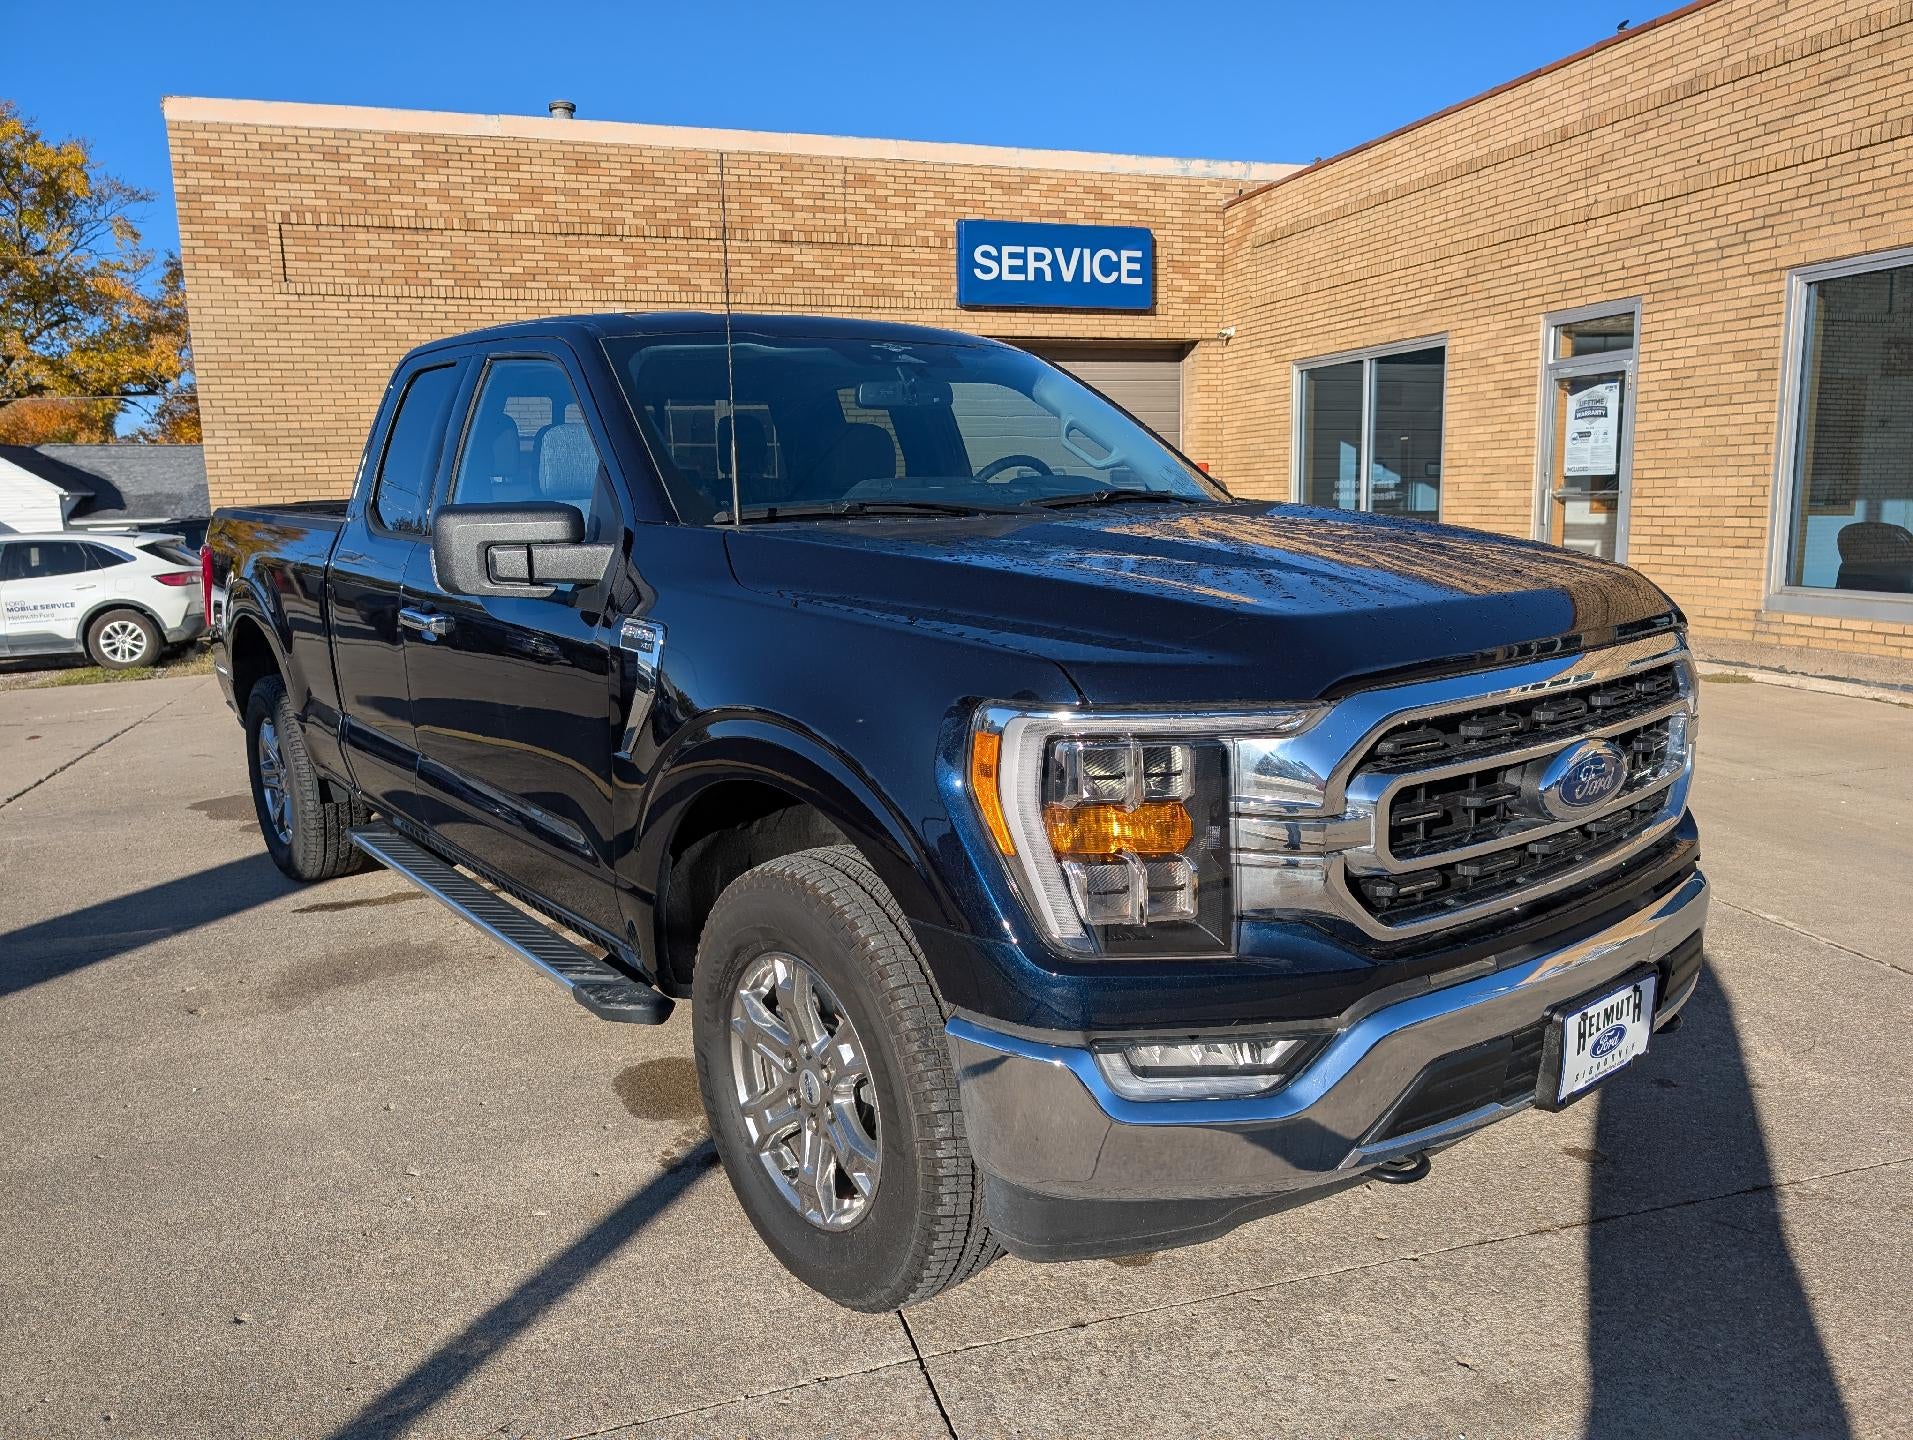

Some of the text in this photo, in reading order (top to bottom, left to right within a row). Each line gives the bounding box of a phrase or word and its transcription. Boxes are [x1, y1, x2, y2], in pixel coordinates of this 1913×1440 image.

[973, 244, 1143, 285] SERVICE
[1576, 410, 1606, 418] WARRANTY
[1579, 399, 1605, 407] LIFETIME
[6, 602, 76, 613] MOBILE SERVICE
[1576, 762, 1615, 800] Ford
[1576, 987, 1643, 1057] HELMUTH
[1596, 1030, 1621, 1055] Ford
